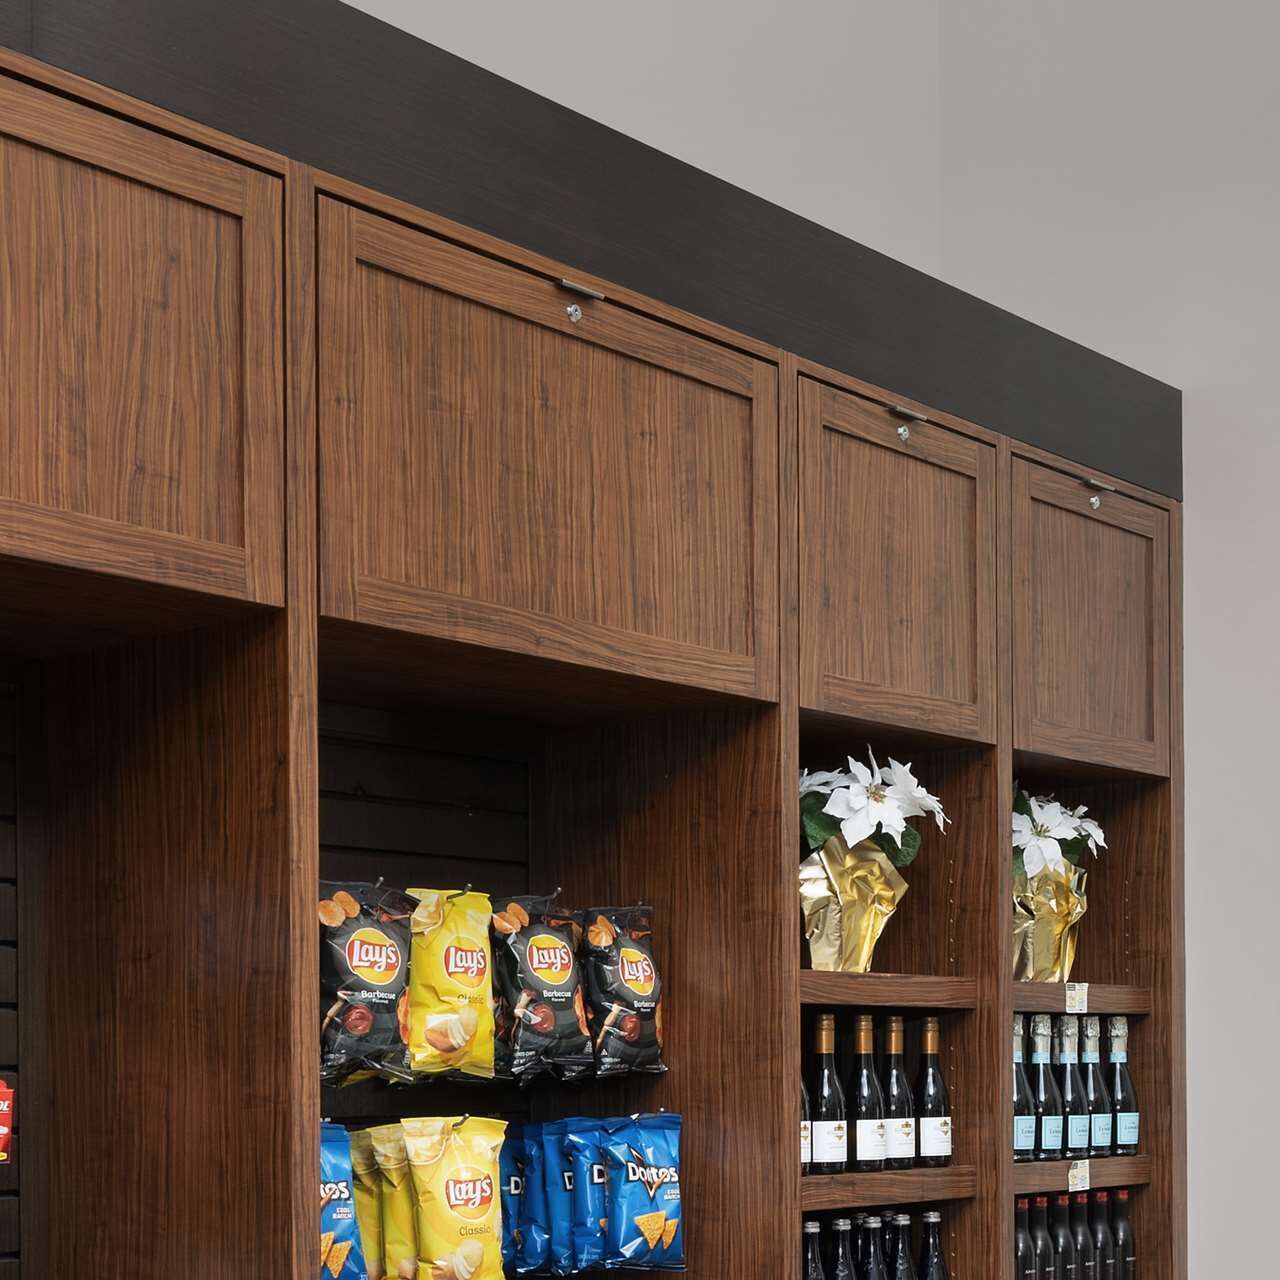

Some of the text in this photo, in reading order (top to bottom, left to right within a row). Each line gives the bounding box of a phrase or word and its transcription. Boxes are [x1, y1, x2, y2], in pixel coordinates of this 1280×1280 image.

[352, 936, 398, 971] Lay's
[446, 947, 487, 980] Lay's
[532, 941, 572, 974] Lay's
[361, 989, 396, 1001] Barbecue
[543, 989, 572, 999] Barbecue
[627, 1161, 679, 1186] Doritos
[445, 1174, 494, 1210] Lay's
[459, 1224, 491, 1238] Classic
